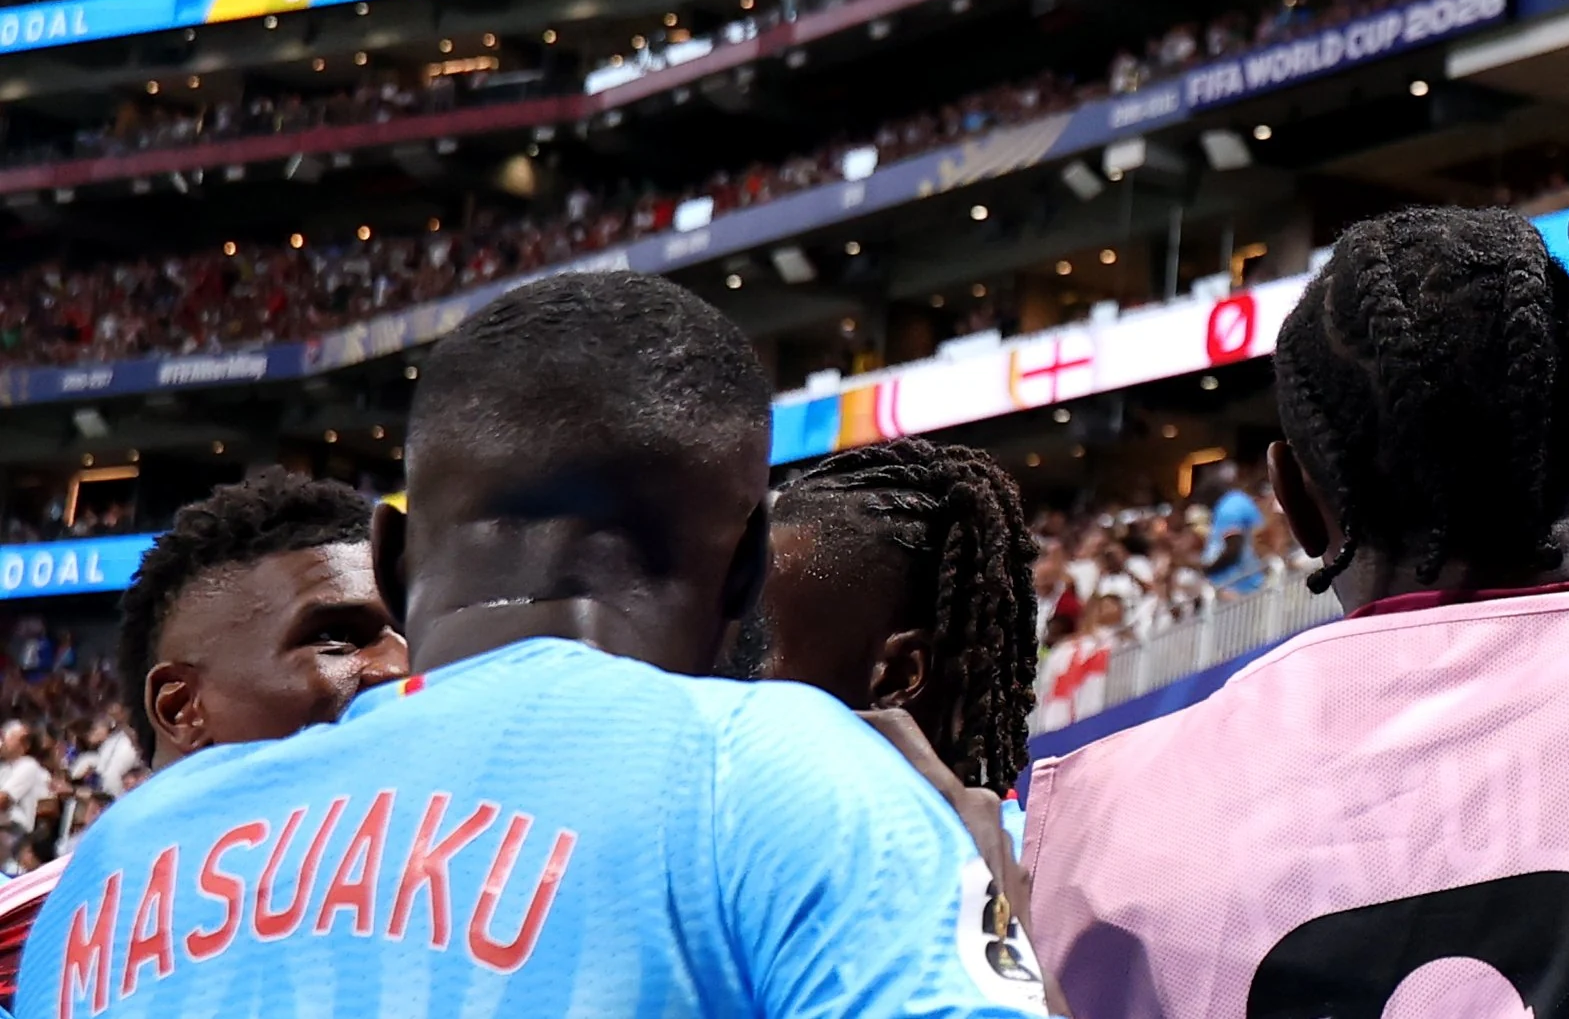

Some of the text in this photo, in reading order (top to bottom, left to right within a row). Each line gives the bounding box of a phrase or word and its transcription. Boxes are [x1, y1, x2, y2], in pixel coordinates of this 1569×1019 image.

[1186, 61, 1245, 108] FIFA
[1245, 28, 1344, 90] WORLD
[1345, 8, 1402, 60] CUP
[59, 788, 578, 1019] MASUAKU
